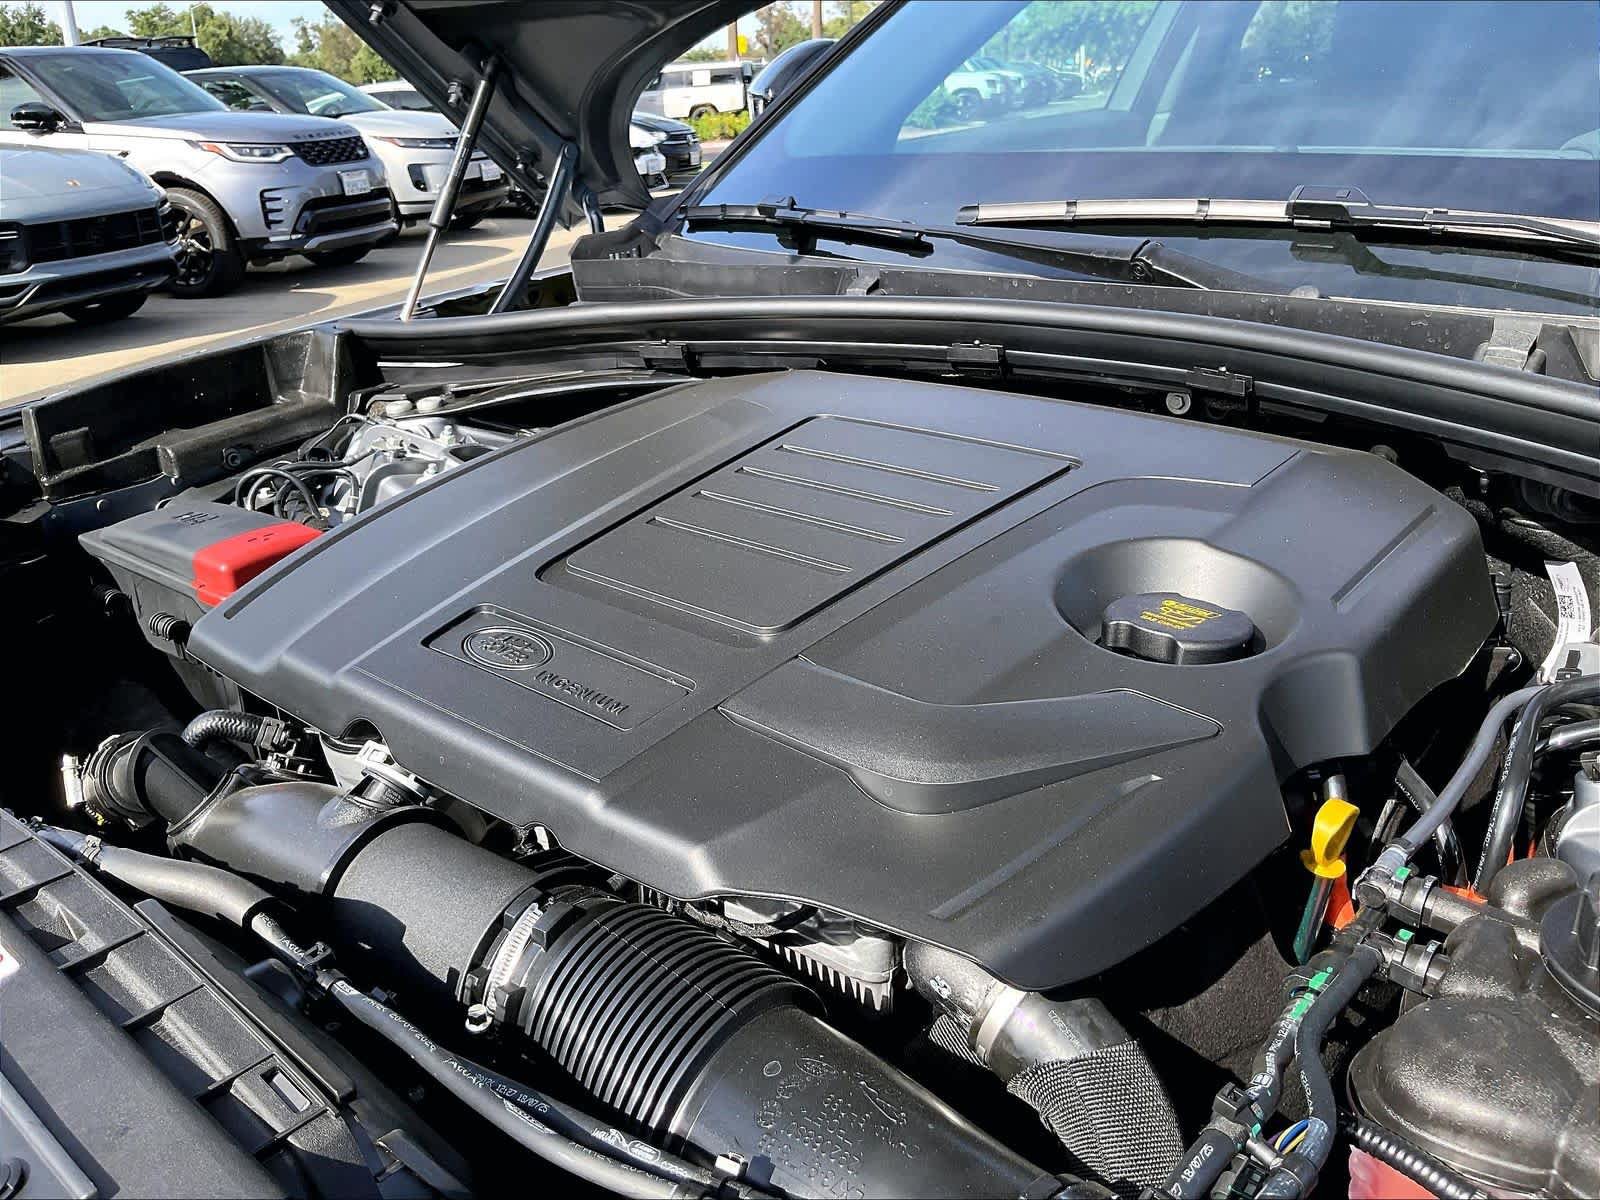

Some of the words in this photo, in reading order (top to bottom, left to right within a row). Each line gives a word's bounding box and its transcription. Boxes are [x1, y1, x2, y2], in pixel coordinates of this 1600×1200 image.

[533, 670, 630, 716] INGENIUM
[279, 935, 306, 958] JAGUA
[516, 1092, 550, 1114] 18/07/25
[1181, 1143, 1214, 1182] 18/07/25
